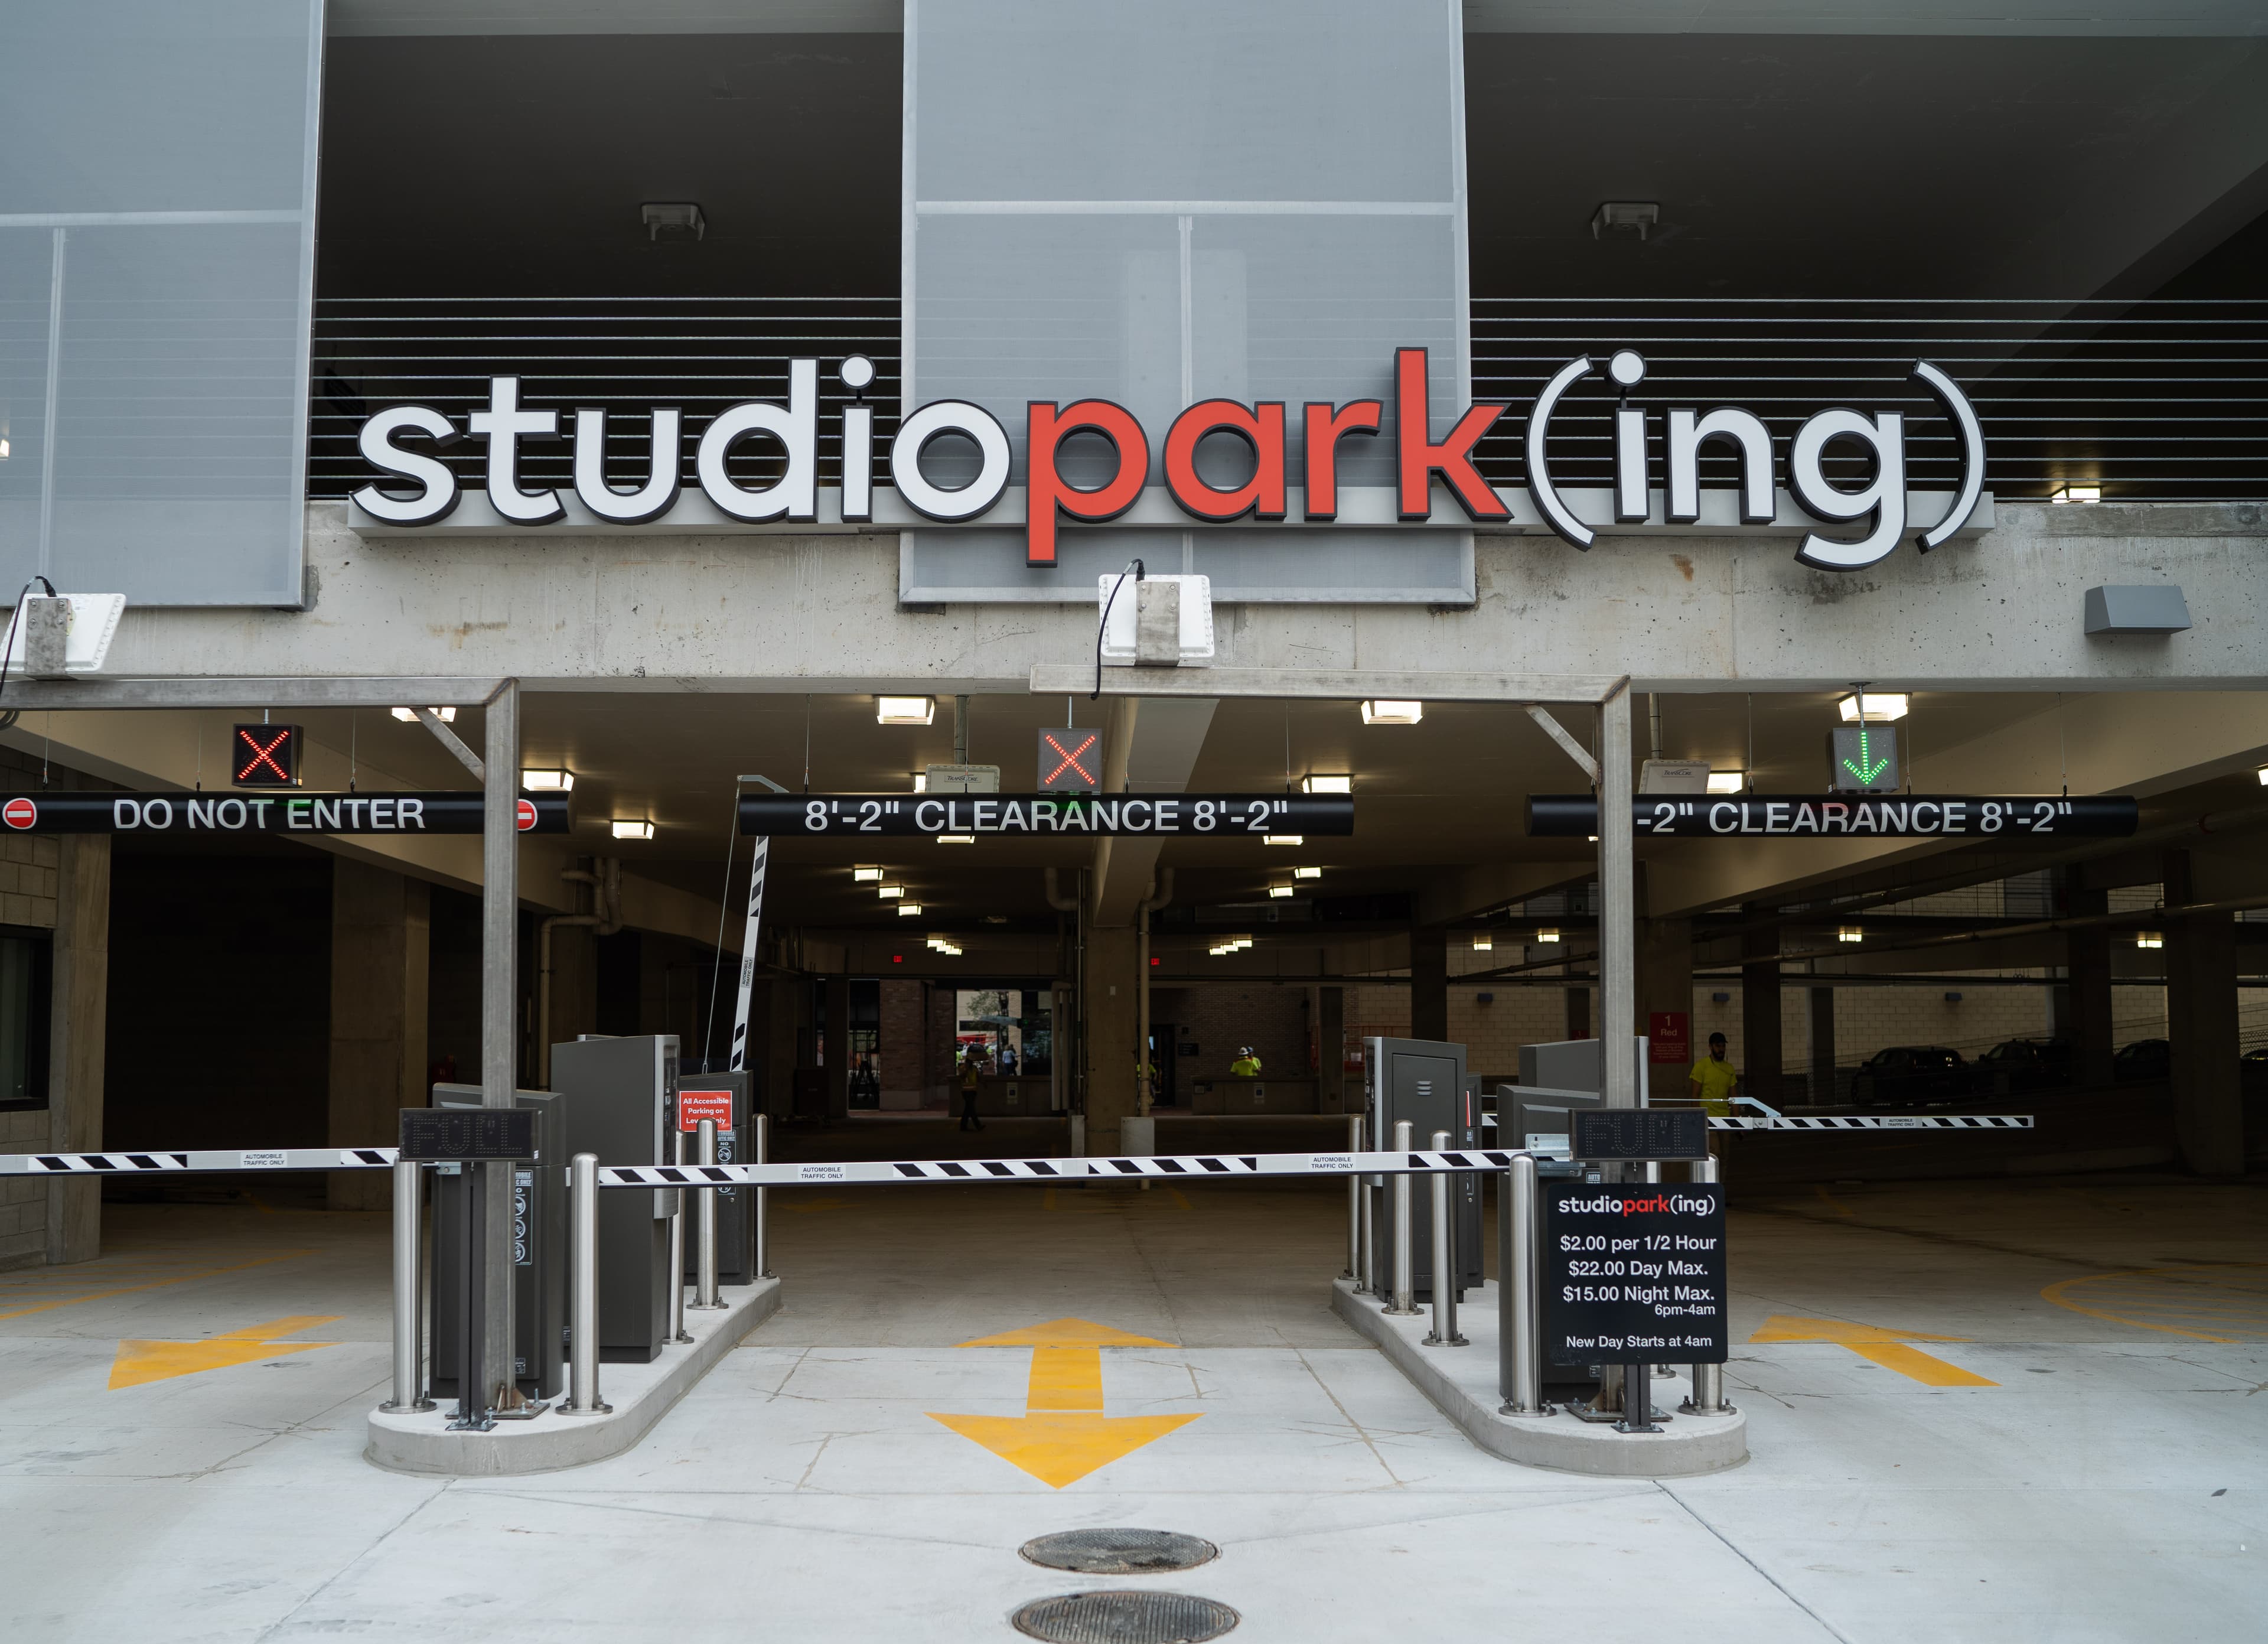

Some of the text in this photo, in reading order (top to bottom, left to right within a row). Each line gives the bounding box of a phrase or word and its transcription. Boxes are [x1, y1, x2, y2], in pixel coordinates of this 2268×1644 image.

[114, 799, 425, 828] DO NOT ENTER
[806, 800, 1287, 831] 8'-2" CLEARANCE 8'-2"
[1637, 802, 2071, 832] -2" CLEARANCE 8'-2"
[1664, 1015, 1670, 1026] 1
[1558, 1194, 1716, 1217] studiopark(ing)
[1560, 1235, 1716, 1254] $2.00 per 1/2 Hour
[1569, 1260, 1708, 1279] $22.00 Day Max.
[1563, 1285, 1715, 1304] $15.00 Night Max.
[1655, 1304, 1715, 1317] 6pm-4am
[1567, 1335, 1712, 1350] New Day Starts at 4am
